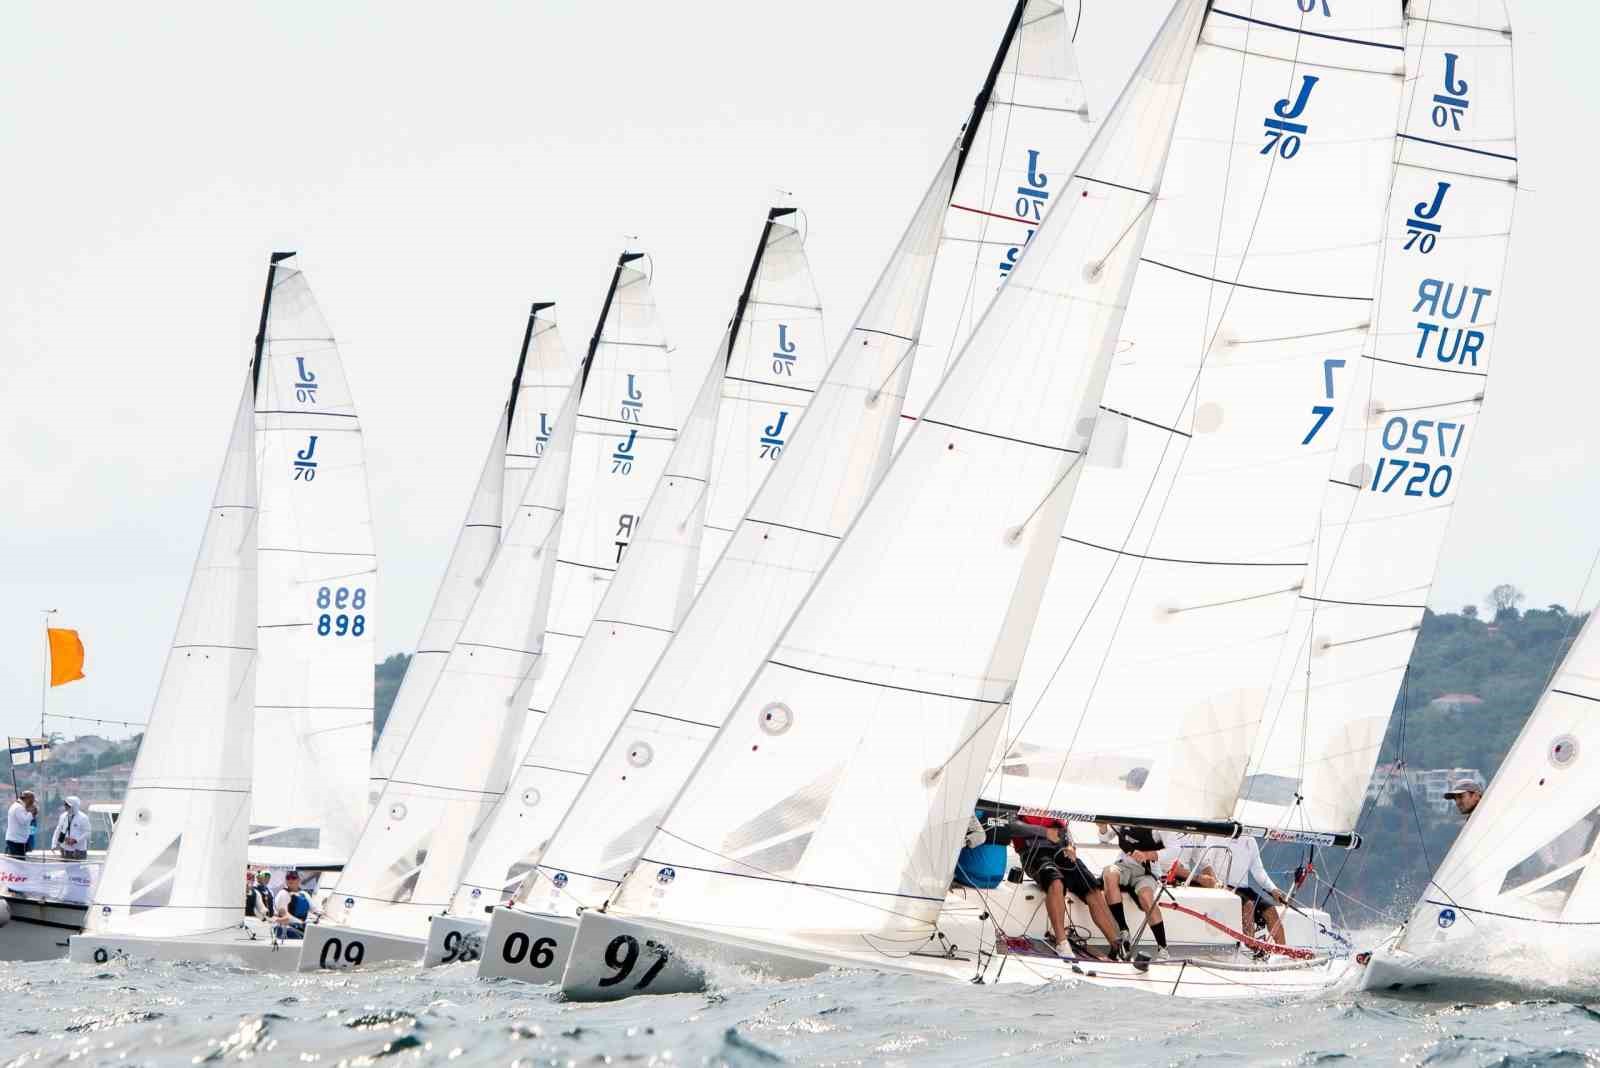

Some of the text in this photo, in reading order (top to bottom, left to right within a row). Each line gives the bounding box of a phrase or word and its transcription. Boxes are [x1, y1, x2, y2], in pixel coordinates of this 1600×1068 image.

[1274, 75, 1319, 119] J
[1260, 131, 1301, 160] 70
[1414, 182, 1451, 219] J
[1403, 229, 1436, 254] 70
[1416, 322, 1485, 366] TUR
[764, 411, 788, 437] J
[1302, 406, 1334, 445] 7
[297, 435, 318, 460] J
[617, 429, 638, 453] J
[759, 444, 782, 460] 70
[293, 467, 316, 482] 70
[611, 460, 632, 475] 70
[1371, 457, 1453, 498] 1720
[317, 613, 366, 637] 898
[320, 937, 365, 969] 09
[502, 931, 558, 969] 06
[598, 934, 674, 990] 97
